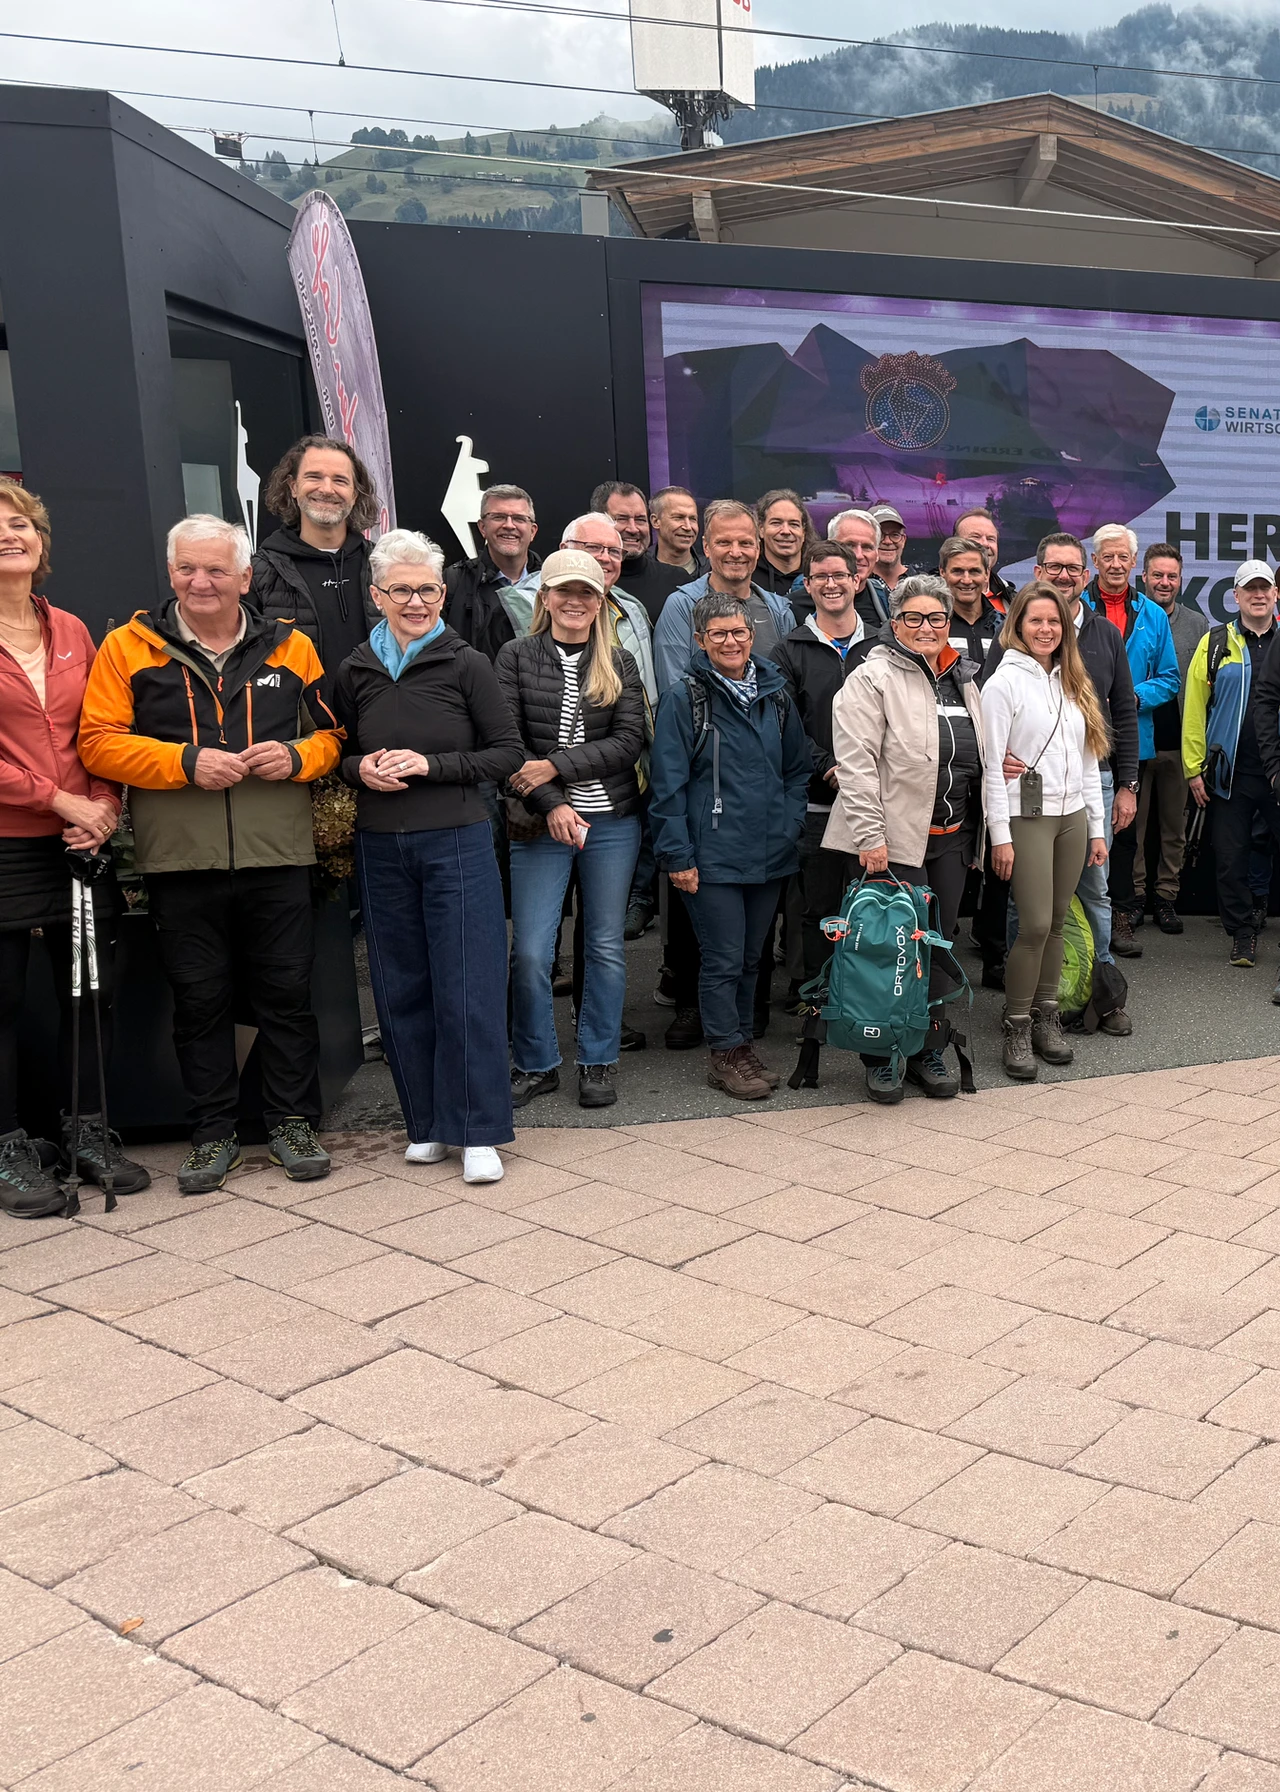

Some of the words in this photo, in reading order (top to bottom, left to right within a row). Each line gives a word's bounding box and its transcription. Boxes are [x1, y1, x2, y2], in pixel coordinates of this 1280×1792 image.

[72, 906, 81, 940] LEKI
[83, 899, 94, 932] LEKI
[893, 925, 905, 997] ORTOVOX
